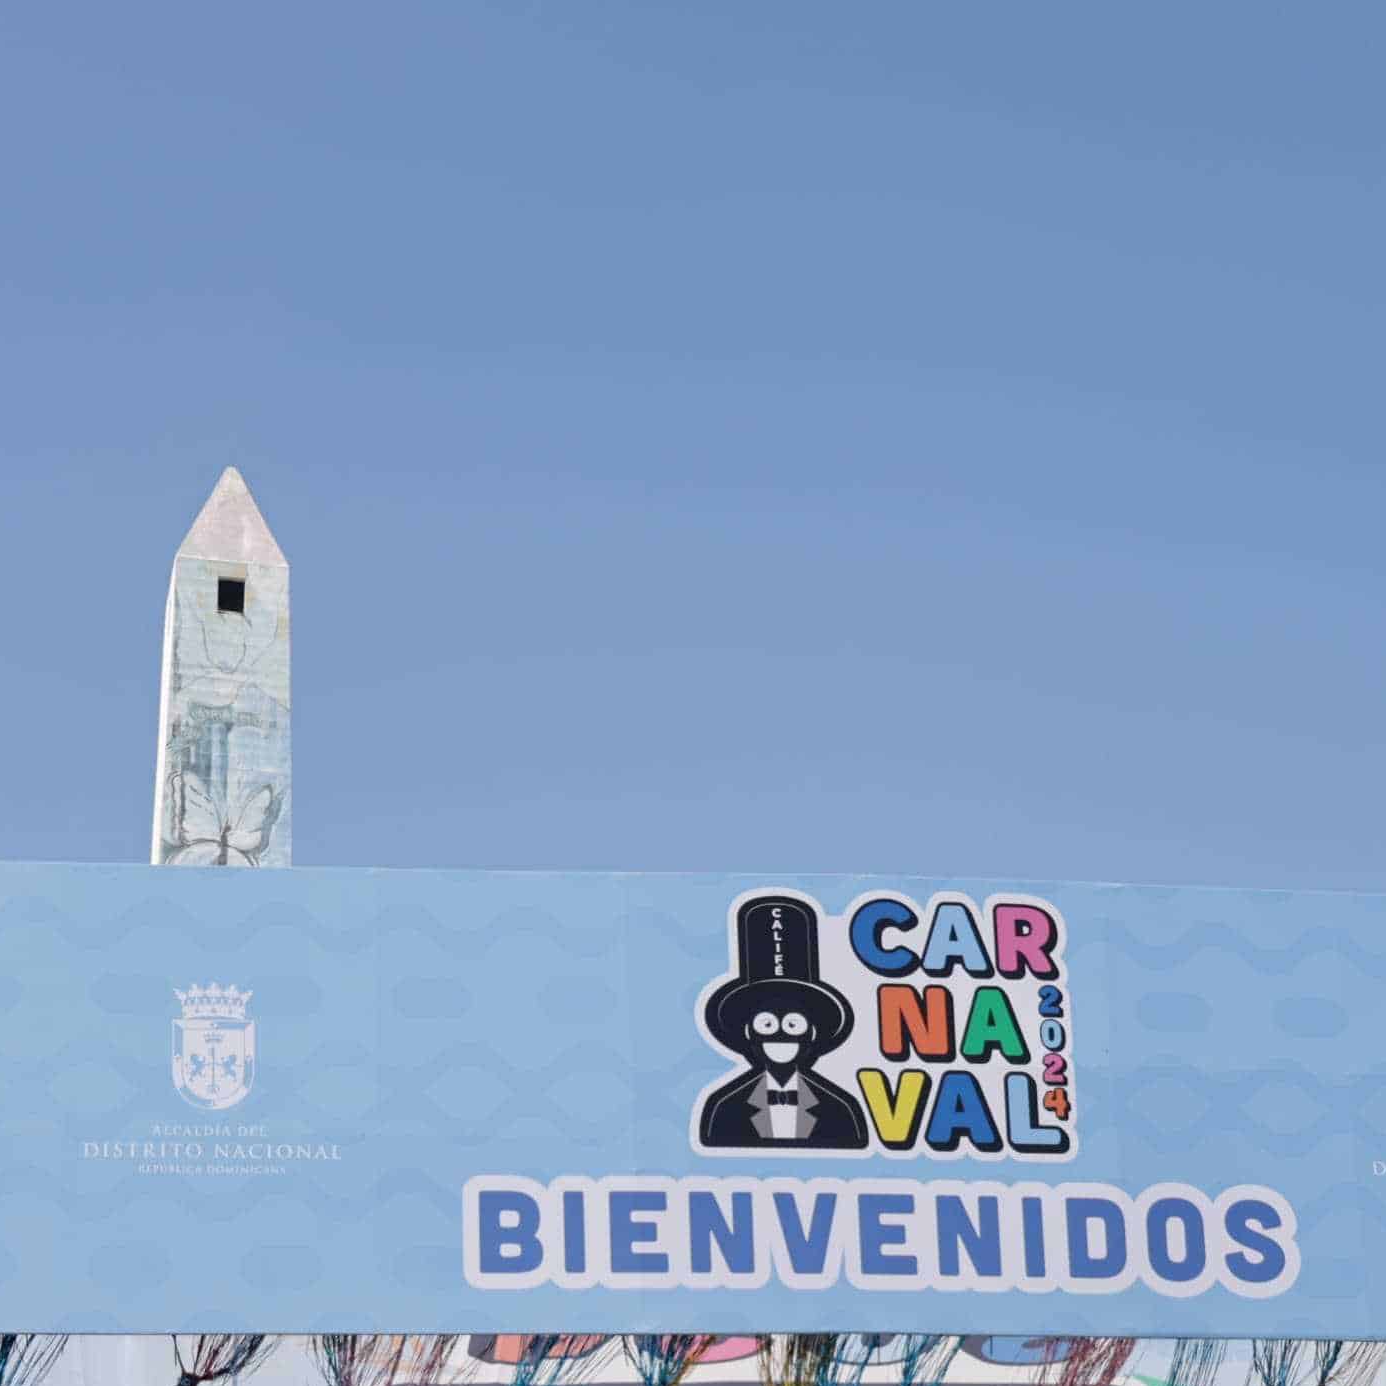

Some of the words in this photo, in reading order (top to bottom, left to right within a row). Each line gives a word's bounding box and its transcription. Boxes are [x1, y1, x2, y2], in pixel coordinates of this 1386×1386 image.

[849, 898, 1060, 980] CAR
[877, 983, 1031, 1064] NA
[1038, 985, 1071, 1121] 2024
[83, 1141, 203, 1160] DISTRITO
[214, 1142, 342, 1161] NACIONAL
[856, 1068, 1070, 1154] VAL
[477, 1189, 1287, 1284] BIENVENIDOS
